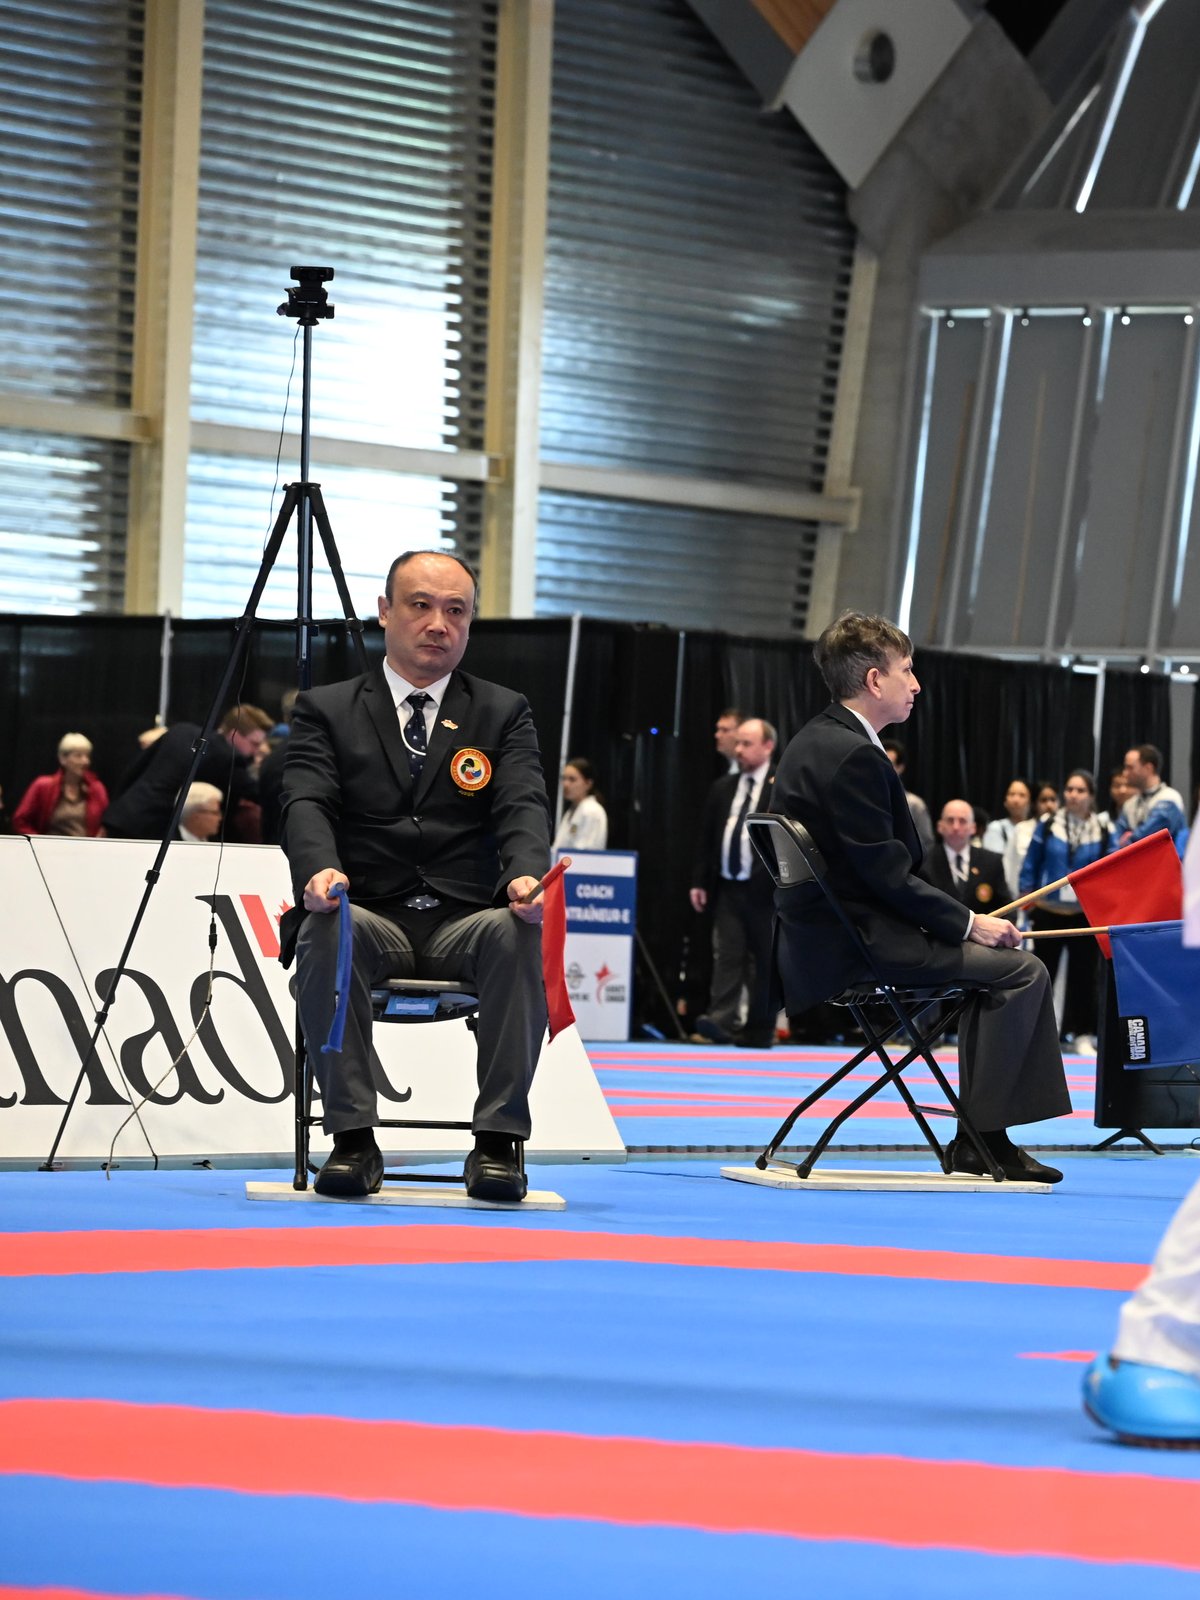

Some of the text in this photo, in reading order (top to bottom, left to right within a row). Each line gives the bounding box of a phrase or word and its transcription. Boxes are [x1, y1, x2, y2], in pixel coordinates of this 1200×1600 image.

[575, 883, 614, 900] COACH
[0, 895, 412, 1107] nad
[1132, 1018, 1146, 1060] CANADA
